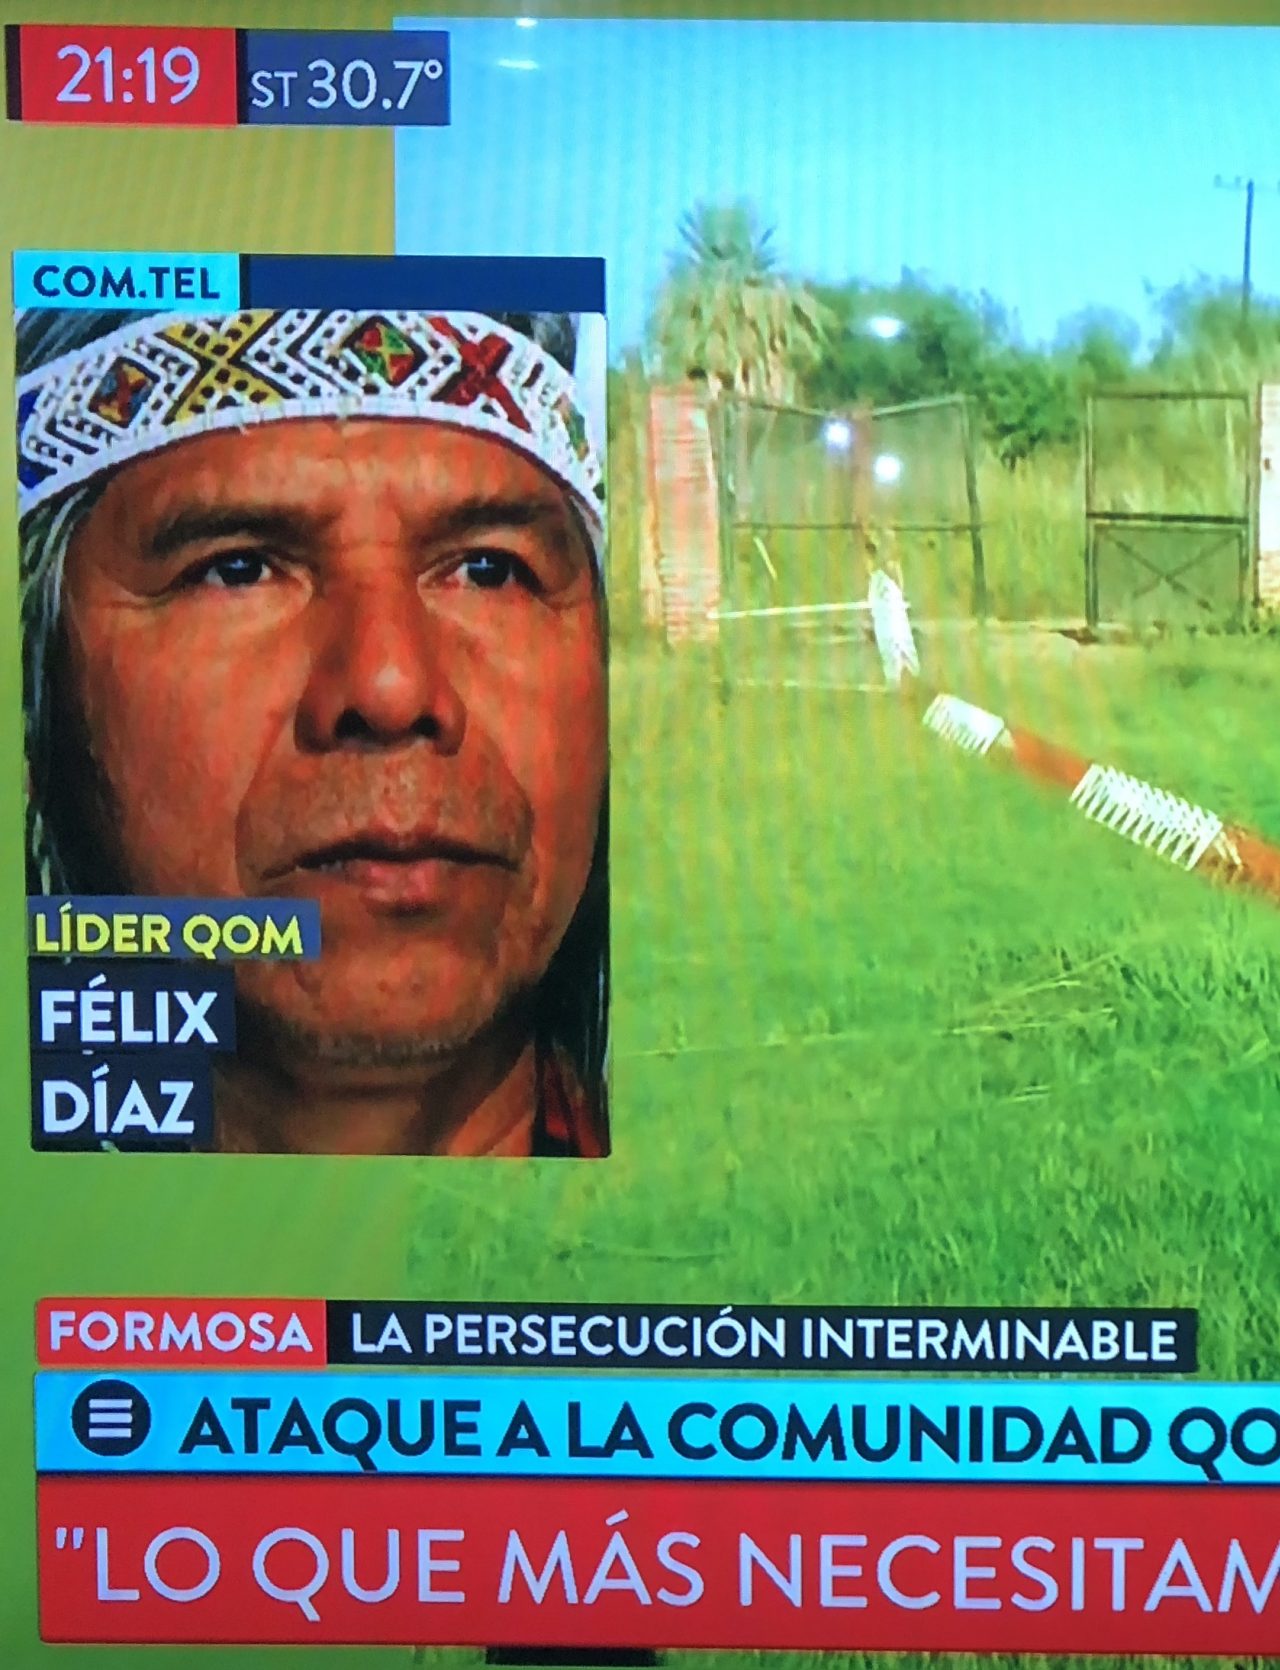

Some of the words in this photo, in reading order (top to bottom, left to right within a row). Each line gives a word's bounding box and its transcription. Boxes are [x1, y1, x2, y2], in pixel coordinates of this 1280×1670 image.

[56, 44, 200, 104] 21:19
[251, 70, 297, 108] ST
[306, 58, 443, 110] 30.7°
[32, 265, 220, 300] COM.TEL
[35, 902, 170, 954] LÍDER
[182, 913, 303, 958] QOM
[40, 974, 218, 1044] FÉLIX
[42, 1064, 195, 1134] DÍAZ
[50, 1311, 313, 1353] FORMOSA
[352, 1313, 412, 1354] LA
[425, 1306, 786, 1359] PERSECUCIÓN
[803, 1317, 1177, 1361] INTERMINABLE
[178, 1396, 483, 1473] ATAQUE
[496, 1401, 551, 1457] A
[568, 1401, 654, 1459] LA
[667, 1402, 1152, 1464] COMUNIDAD
[55, 1526, 220, 1603] "LO
[252, 1527, 465, 1622] QUE
[497, 1510, 704, 1606] MÁS
